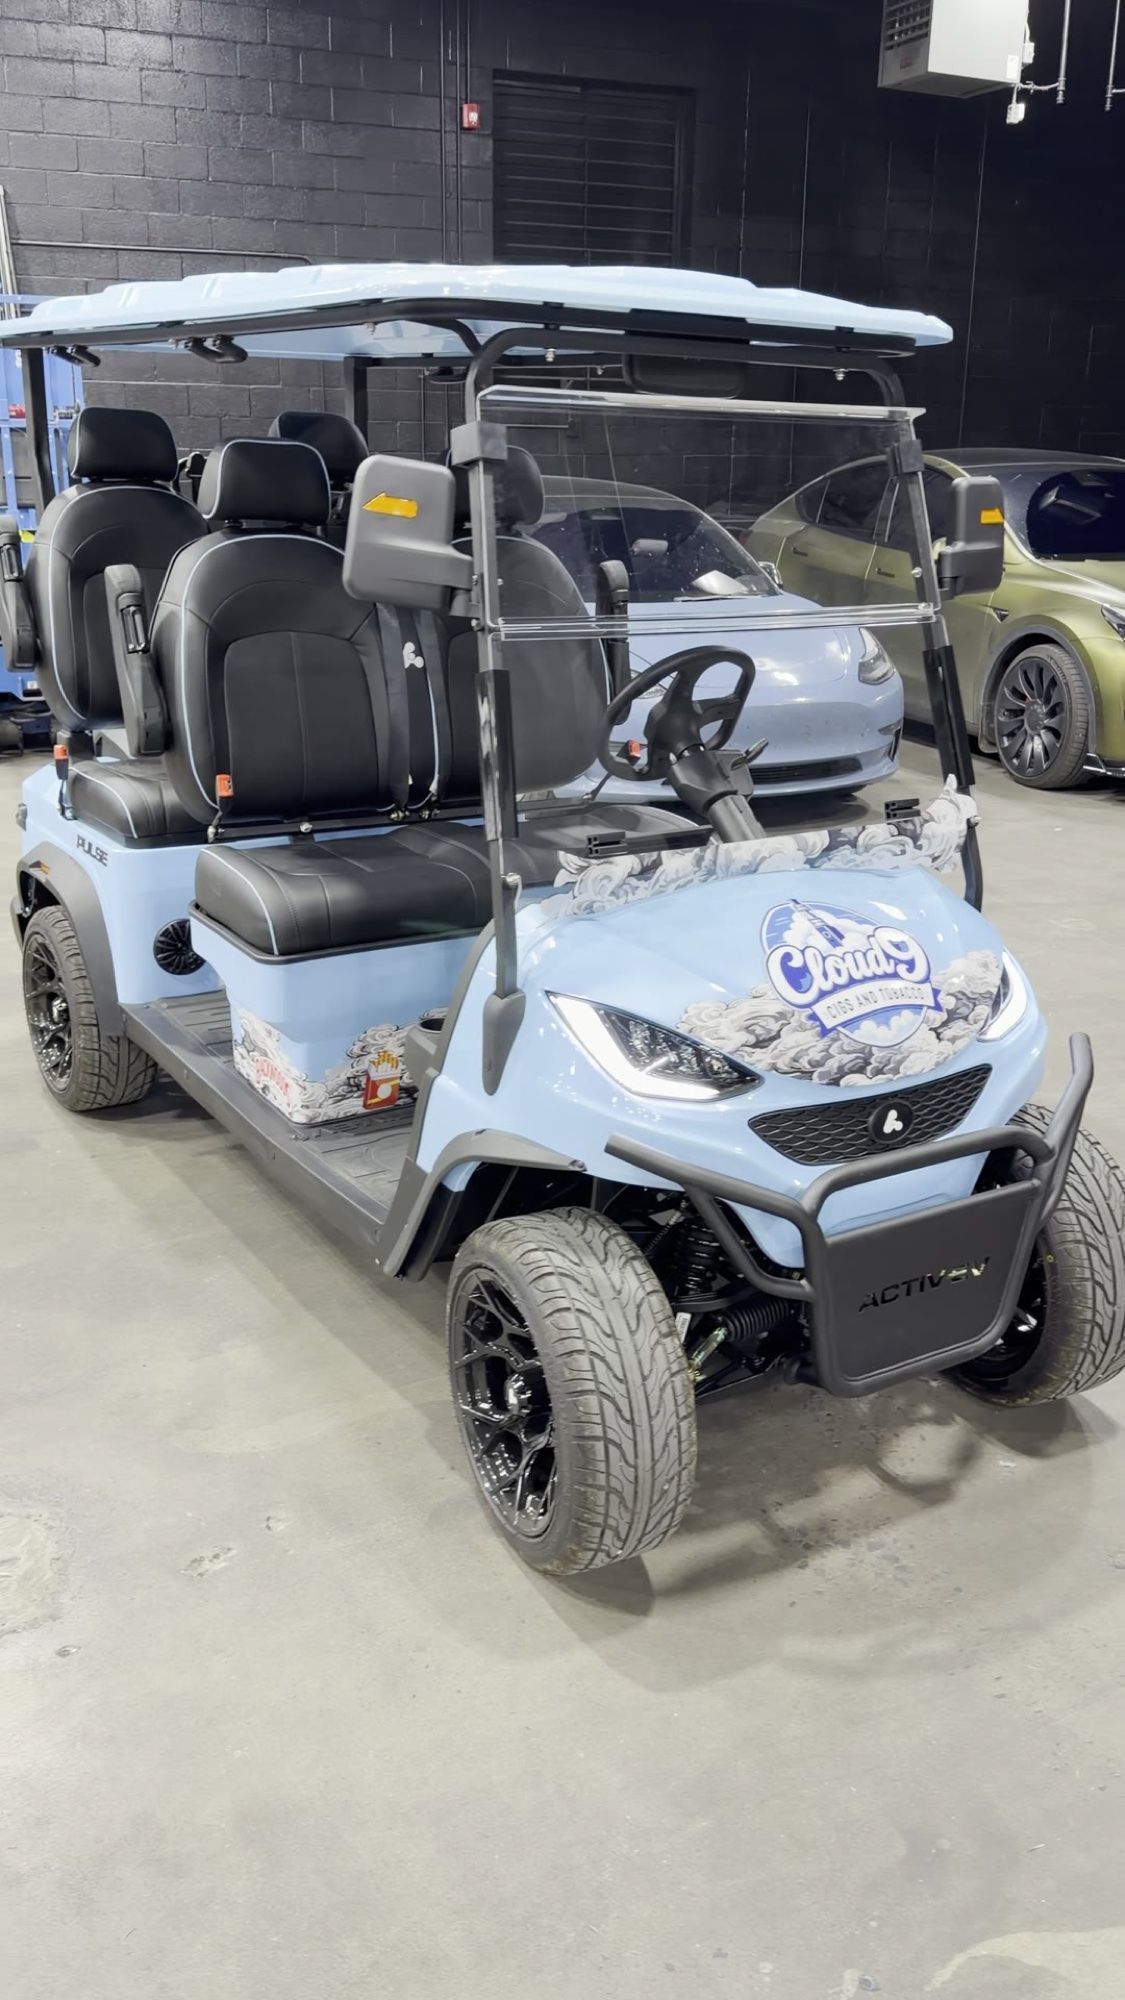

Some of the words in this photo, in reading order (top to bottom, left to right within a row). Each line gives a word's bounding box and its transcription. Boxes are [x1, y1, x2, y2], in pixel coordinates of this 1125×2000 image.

[76, 834, 108, 867] PULSE
[826, 998, 854, 1019] CIGS
[855, 991, 878, 1006] AND
[878, 986, 925, 1001] TOBACCO
